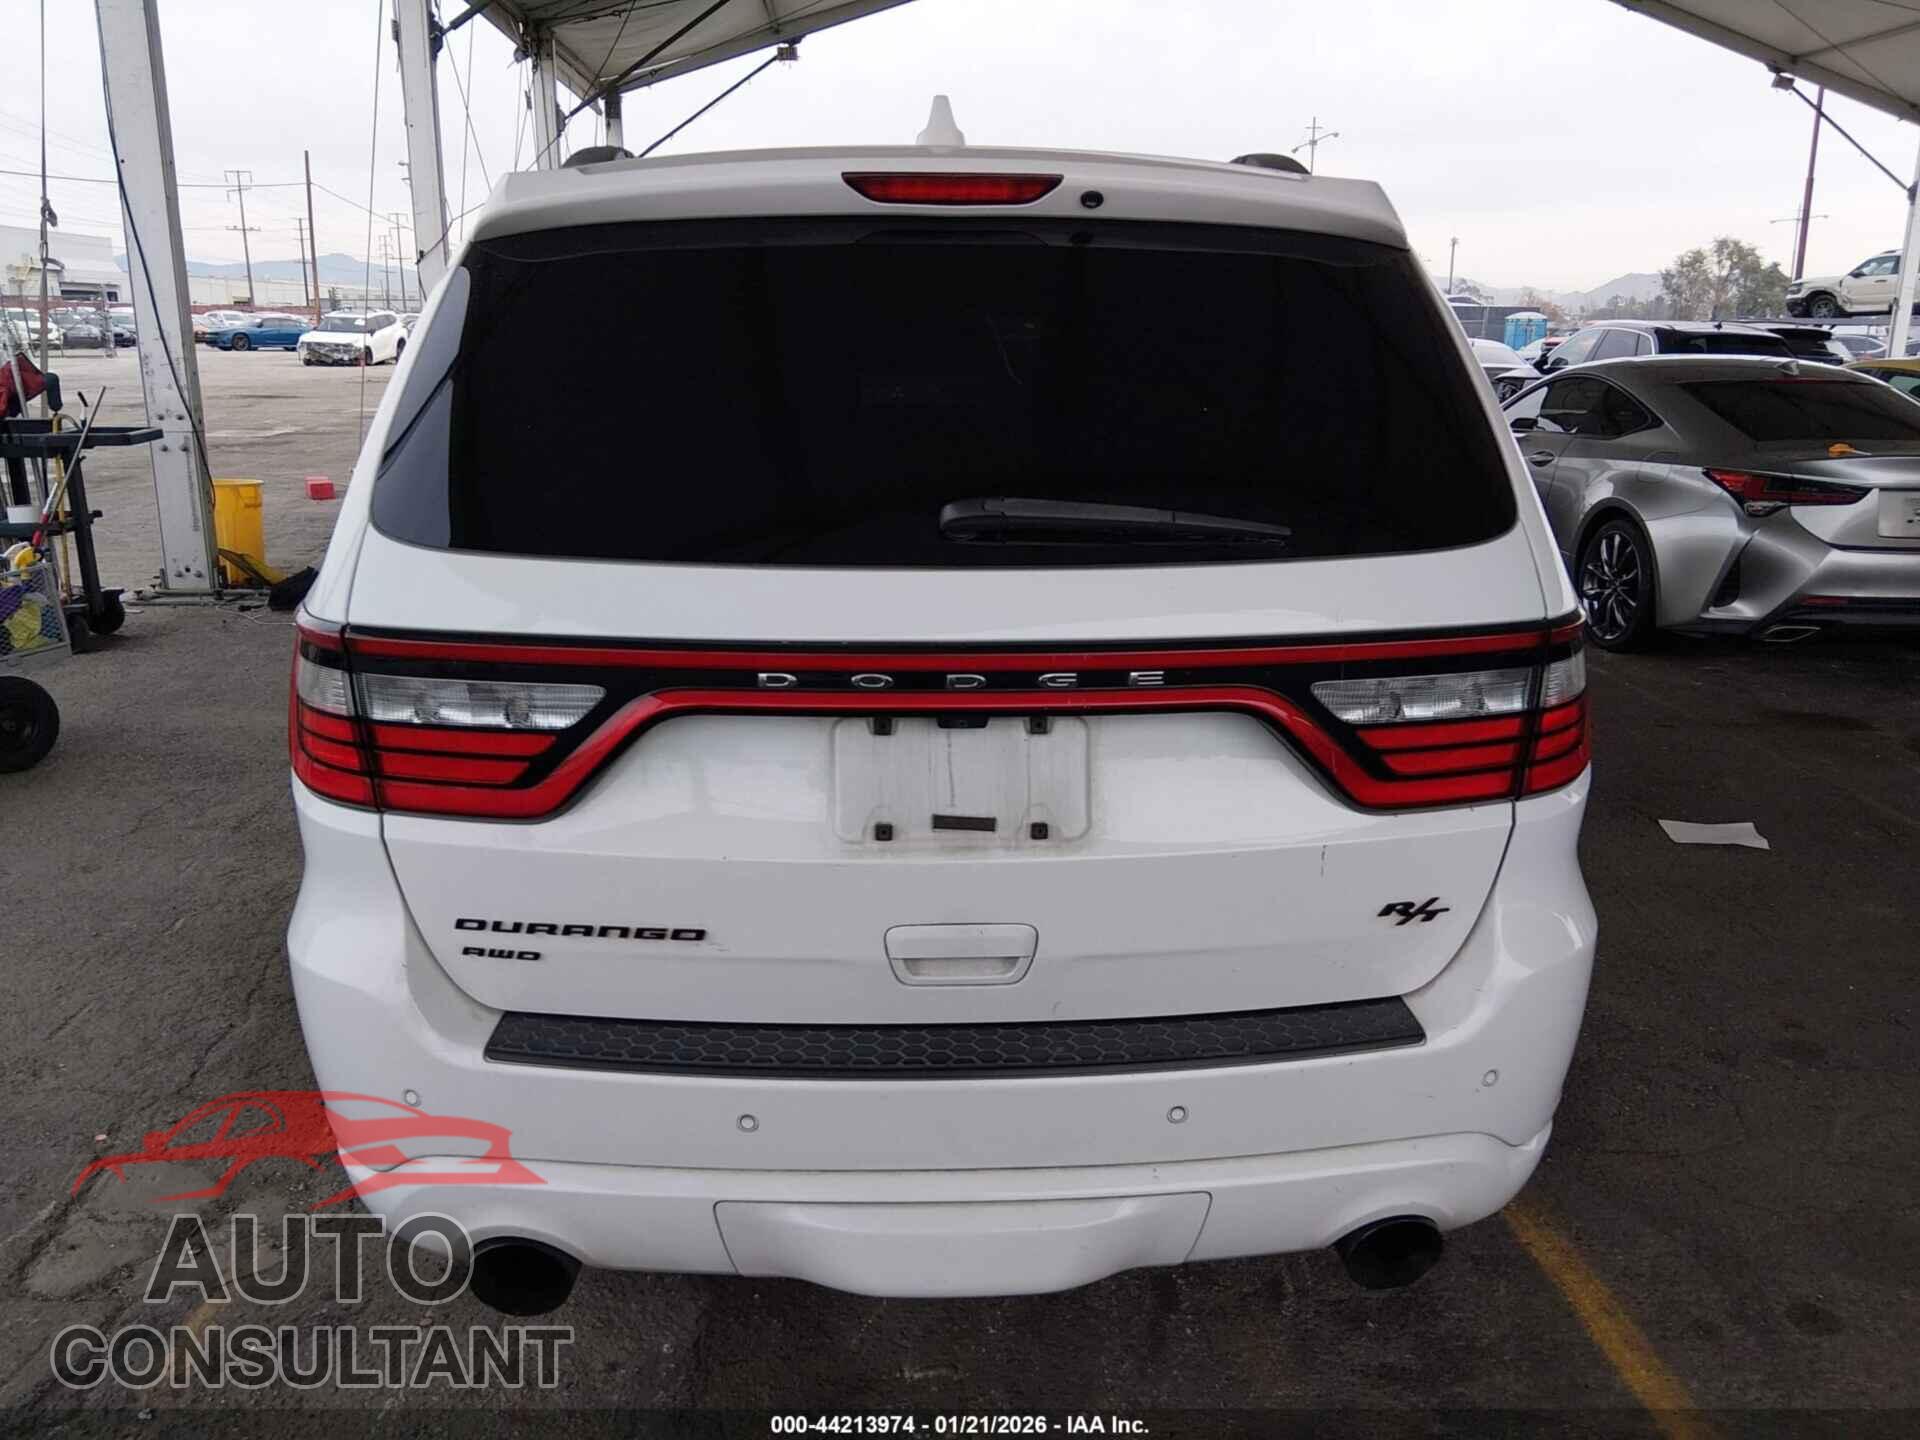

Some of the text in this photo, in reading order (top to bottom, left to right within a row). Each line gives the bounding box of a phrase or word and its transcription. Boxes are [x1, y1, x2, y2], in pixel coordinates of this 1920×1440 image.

[757, 671, 1165, 688] DODGE
[1377, 897, 1450, 926] R/T
[454, 918, 707, 941] DURANGO
[462, 946, 541, 961] AWD
